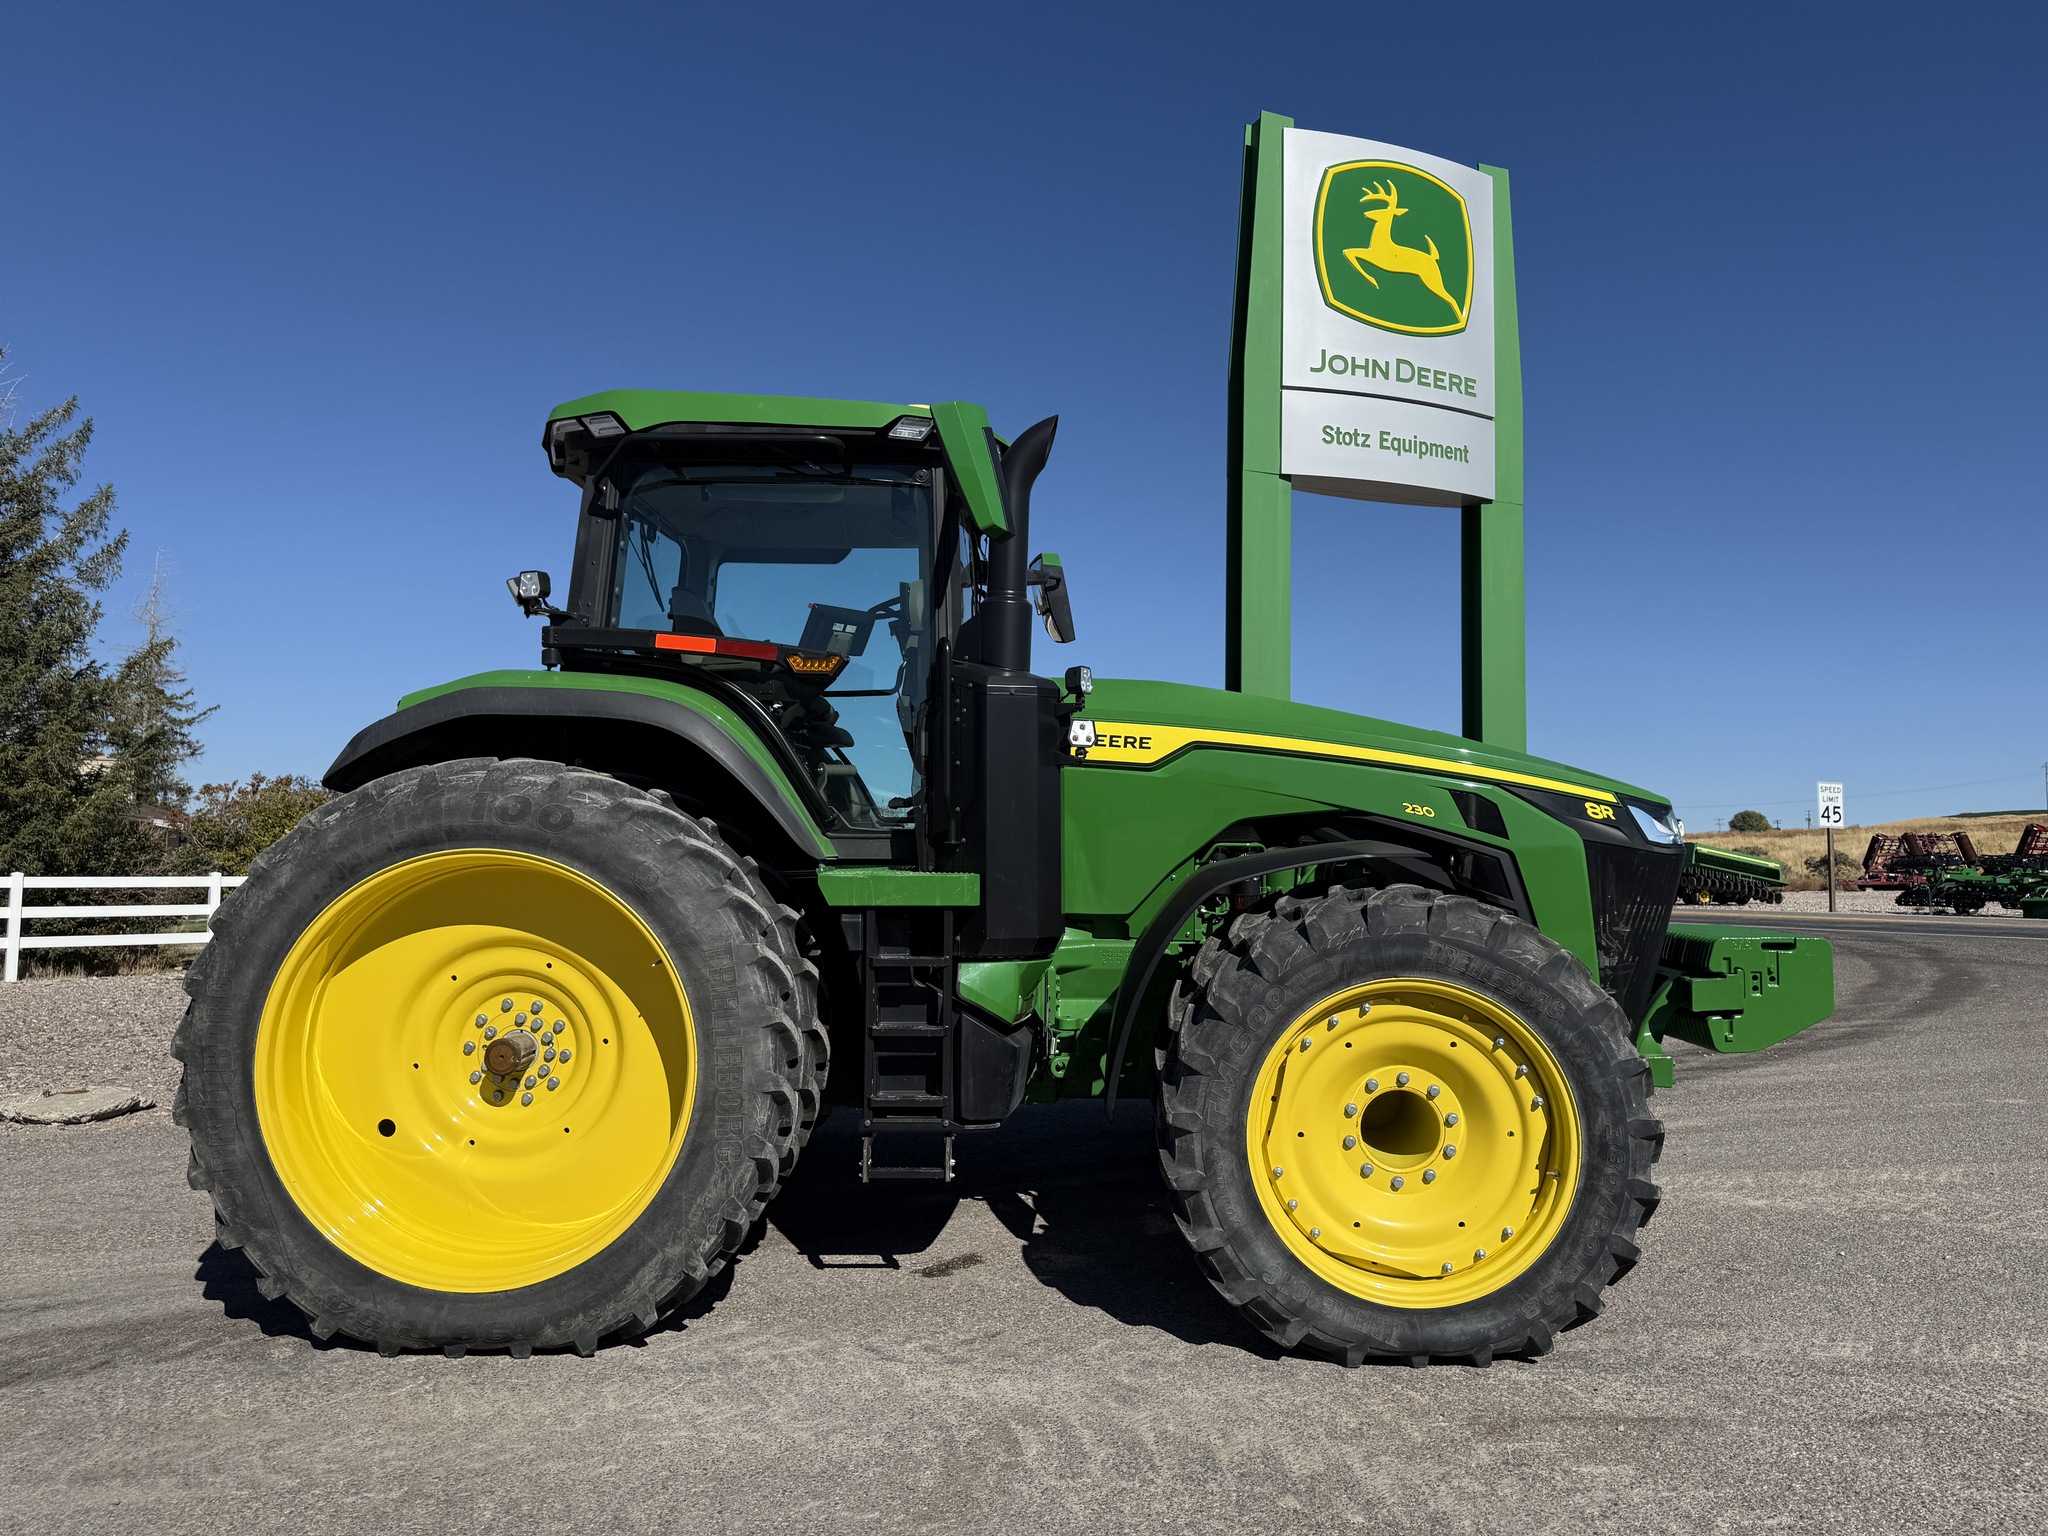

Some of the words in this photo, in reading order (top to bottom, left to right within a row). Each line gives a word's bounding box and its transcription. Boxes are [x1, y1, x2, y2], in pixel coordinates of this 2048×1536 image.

[1310, 348, 1390, 381] JOHN
[1395, 358, 1477, 398] DEERE
[1321, 424, 1371, 449] Stotz
[1378, 430, 1470, 464] Equipment
[1093, 733, 1153, 750] EERE
[1820, 786, 1842, 794] SPEED
[1822, 796, 1840, 804] LIMIT
[1401, 802, 1436, 819] 230
[1584, 801, 1617, 821] 8R
[1820, 805, 1842, 824] 45
[1424, 938, 1568, 1021] TRELLEBORG
[704, 941, 746, 1164] TRELLEBORG
